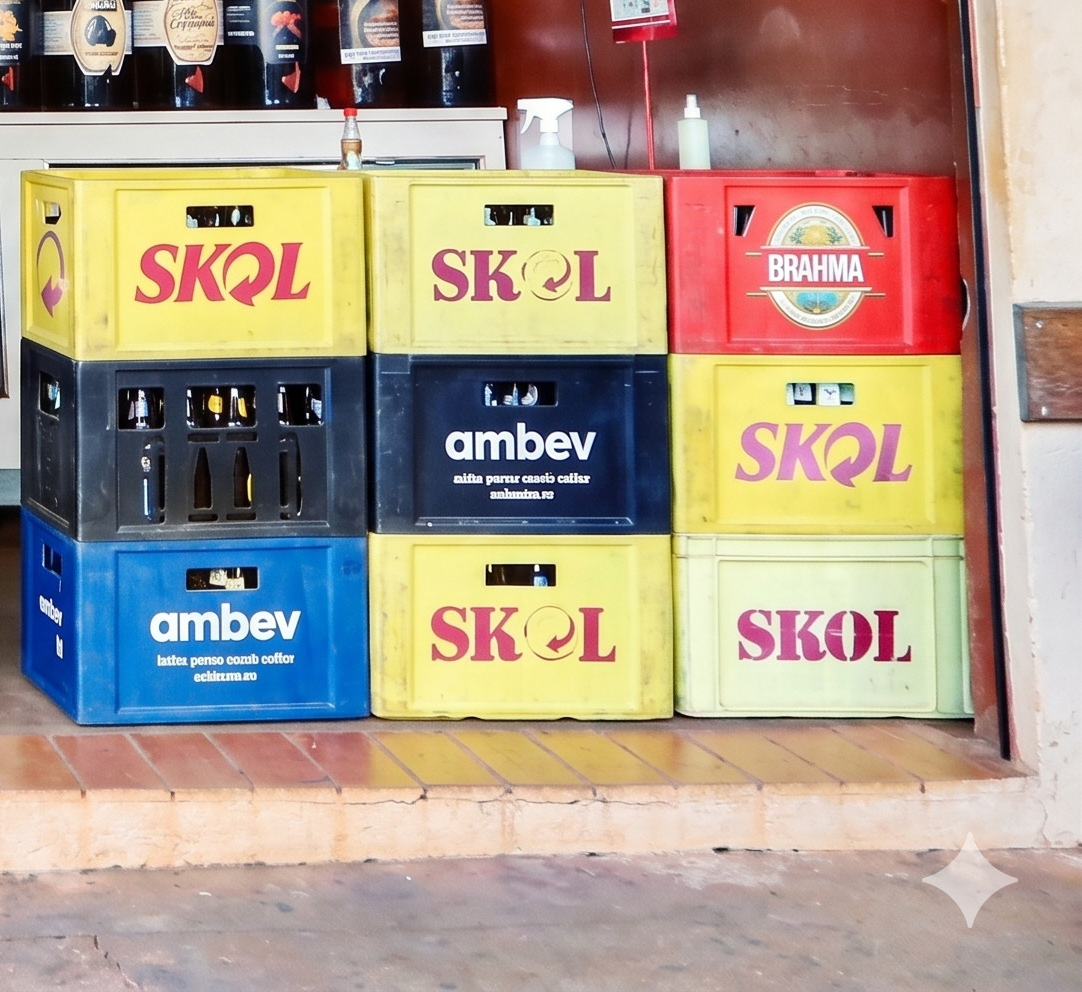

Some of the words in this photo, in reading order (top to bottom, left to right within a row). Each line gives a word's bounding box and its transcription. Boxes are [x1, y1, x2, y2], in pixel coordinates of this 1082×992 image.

[134, 241, 311, 307] SKOL
[431, 248, 612, 302] SKOL
[768, 253, 865, 283] BRAHMA
[445, 422, 597, 461] ambev
[734, 421, 913, 488] SKOL
[39, 595, 63, 627] ambev
[149, 603, 301, 642] ambev
[430, 605, 616, 662] SKOL
[737, 609, 912, 662] SKOL
